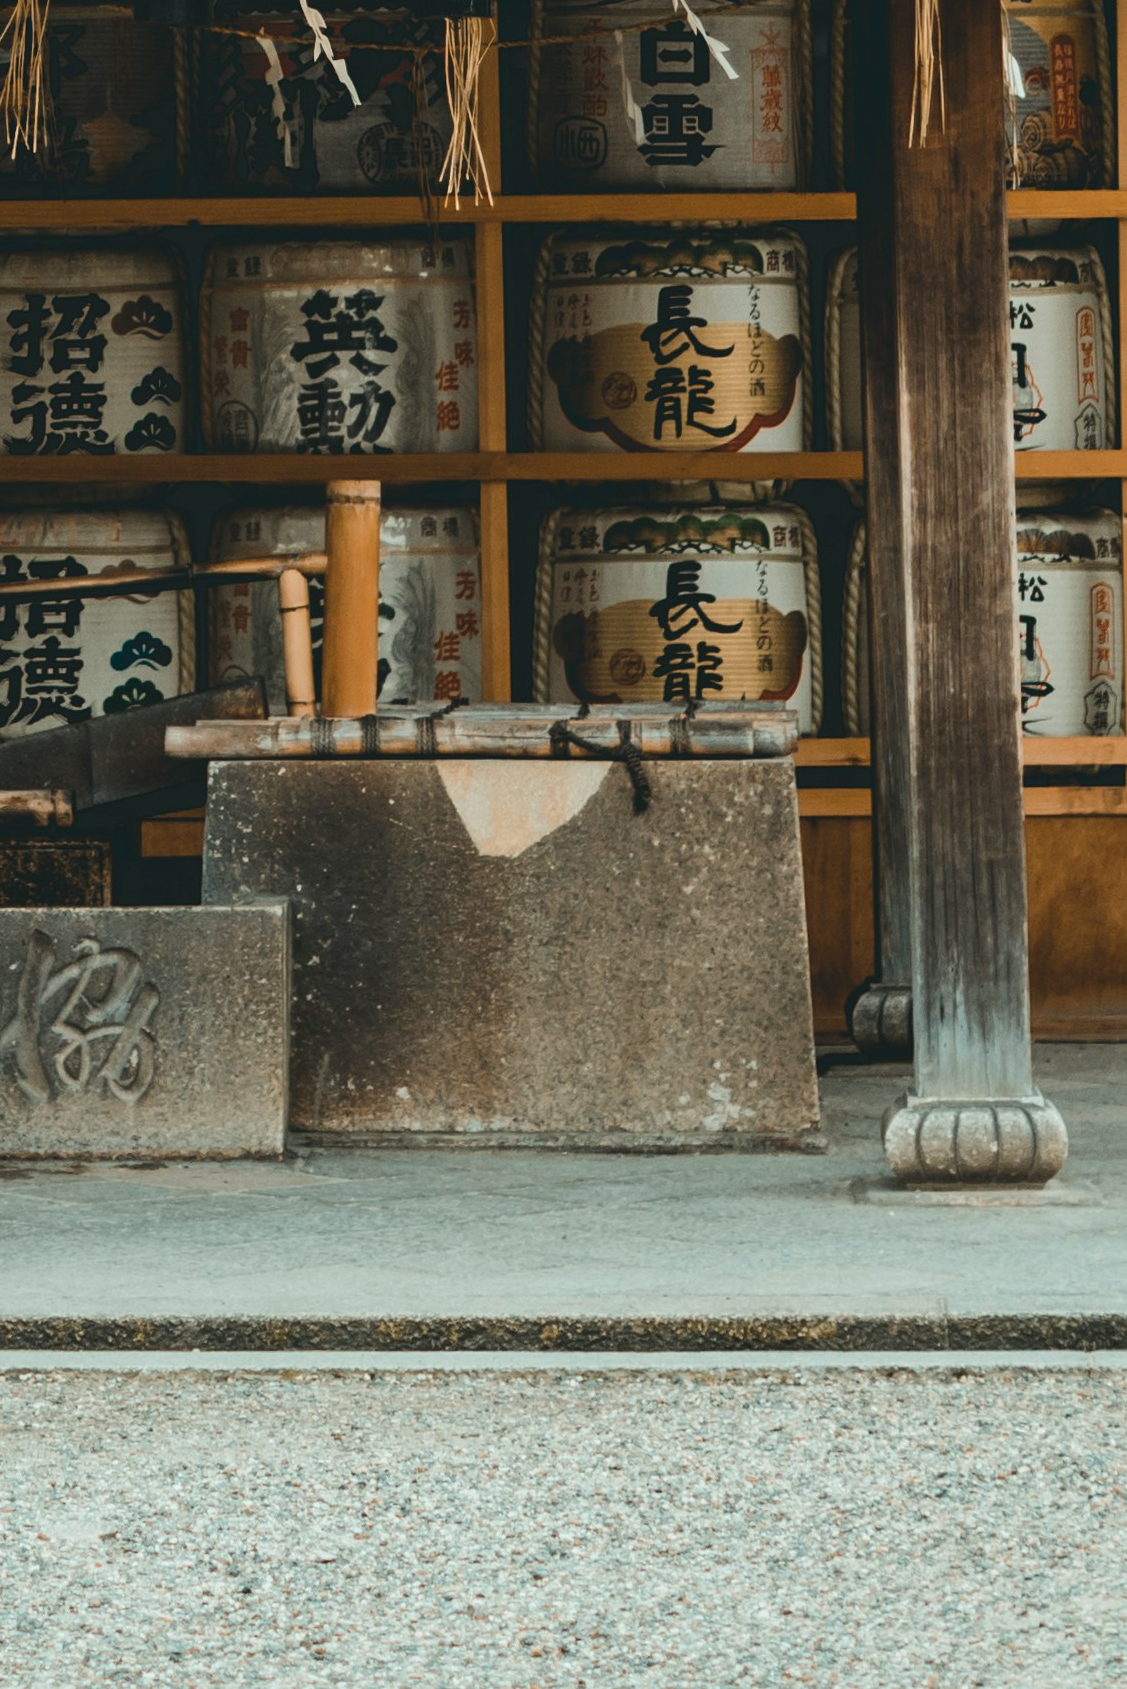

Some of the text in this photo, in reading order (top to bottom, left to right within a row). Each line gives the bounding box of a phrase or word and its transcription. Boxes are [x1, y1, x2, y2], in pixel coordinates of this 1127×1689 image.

[638, 21, 725, 166] 白雪
[452, 300, 476, 370] 芳味
[641, 284, 737, 440] 長龍
[455, 570, 479, 640] 芳味
[650, 561, 743, 701] 長龍
